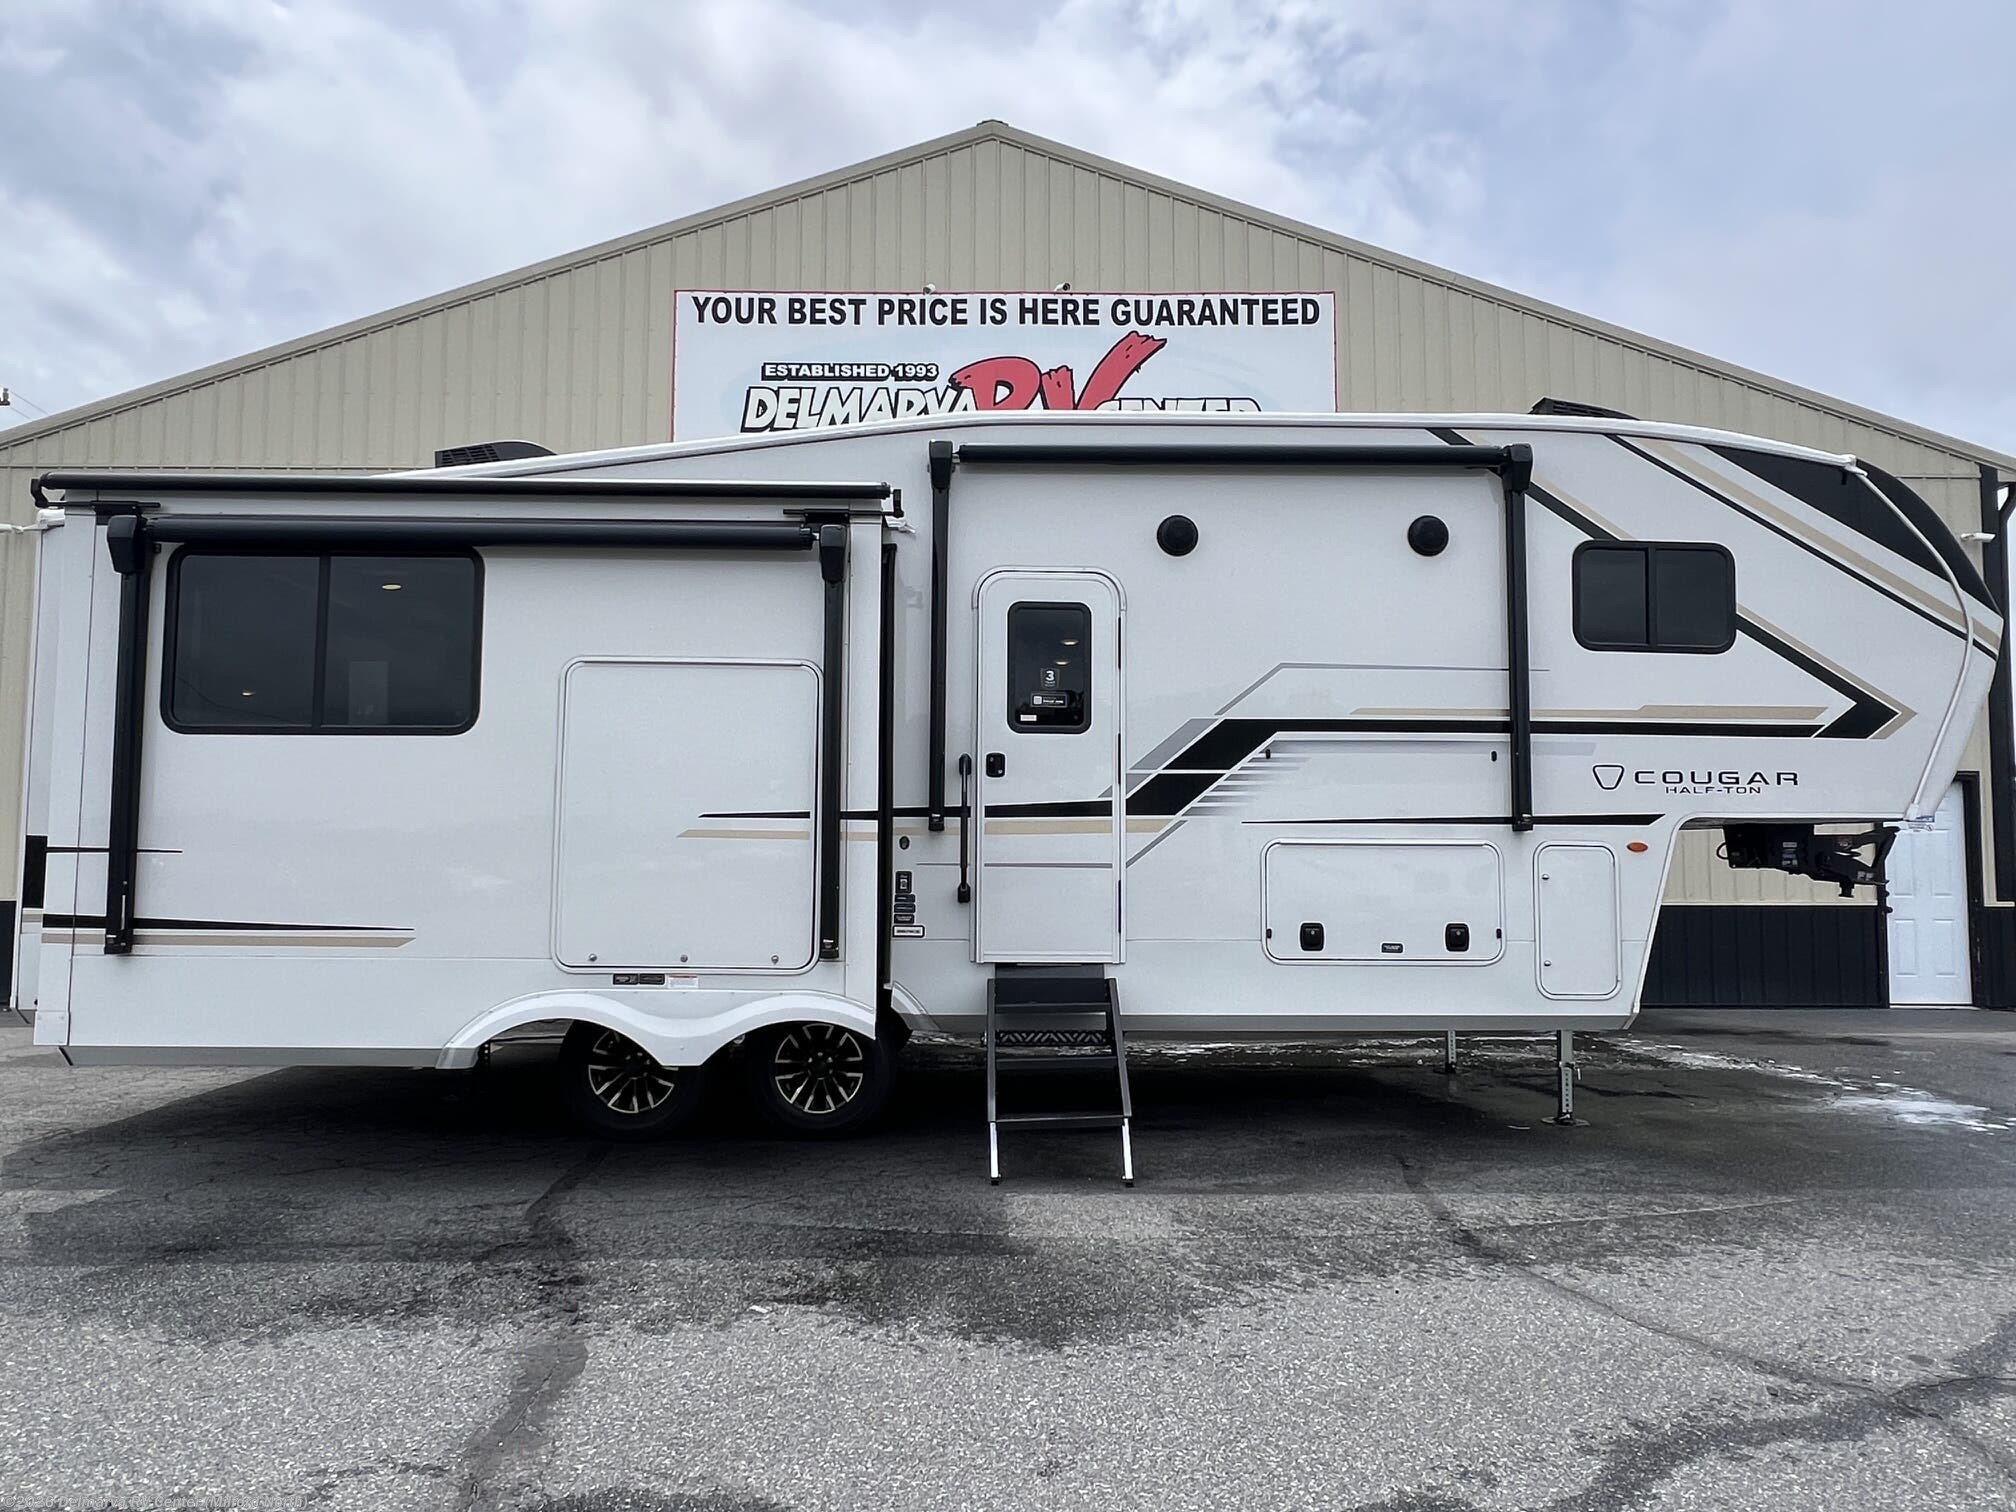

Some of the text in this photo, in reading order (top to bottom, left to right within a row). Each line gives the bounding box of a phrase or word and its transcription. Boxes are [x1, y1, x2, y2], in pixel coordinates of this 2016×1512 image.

[692, 296, 1320, 326] YOUR BEST PRICE IS HERE GUARANTEED
[764, 363, 938, 377] ESTABLISHED 1993
[1045, 670, 1055, 681] 3
[1634, 771, 1799, 786] COUGAR
[1665, 786, 1761, 794] HALF-TON
